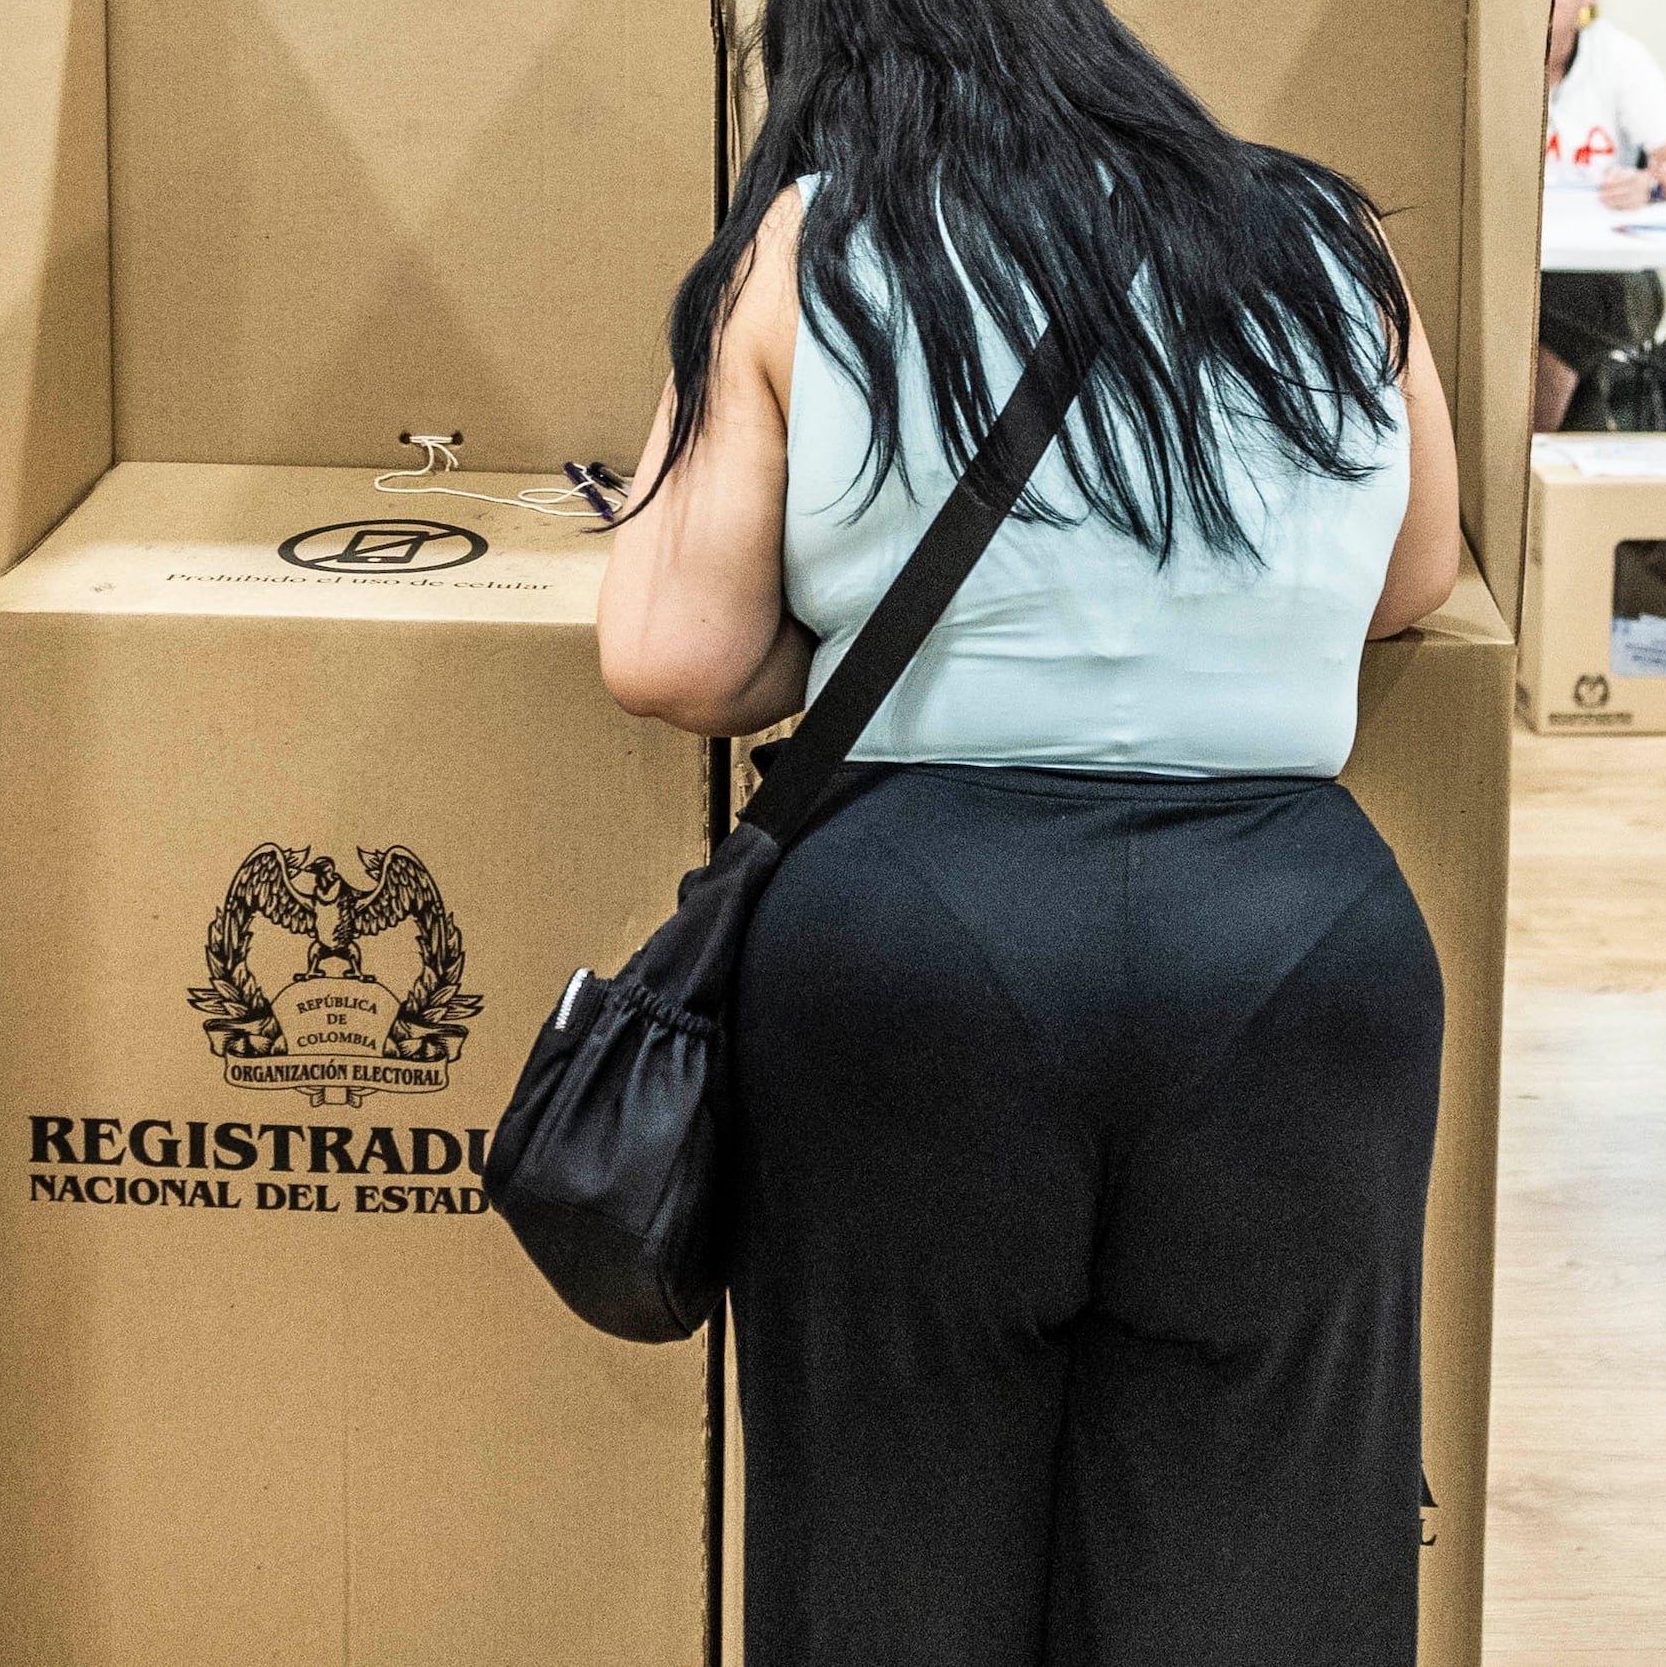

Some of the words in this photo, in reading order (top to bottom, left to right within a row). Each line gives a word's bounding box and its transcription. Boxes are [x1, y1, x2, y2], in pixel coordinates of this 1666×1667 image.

[166, 574, 307, 583] Prohibido
[317, 576, 341, 584] el
[410, 579, 445, 587] de
[454, 581, 553, 590] celular
[296, 993, 377, 1015] REPÚBLICA
[326, 1013, 347, 1025] DE
[297, 1032, 377, 1051] COLOMBIA
[231, 1059, 347, 1082] ORGANIZACIÓN
[353, 1064, 443, 1086] ELECTORAL
[28, 1115, 488, 1176] REGISTRADU
[28, 1174, 241, 1209] NACIONAL
[255, 1181, 340, 1213] DEL
[355, 1185, 490, 1214] ESTAD
